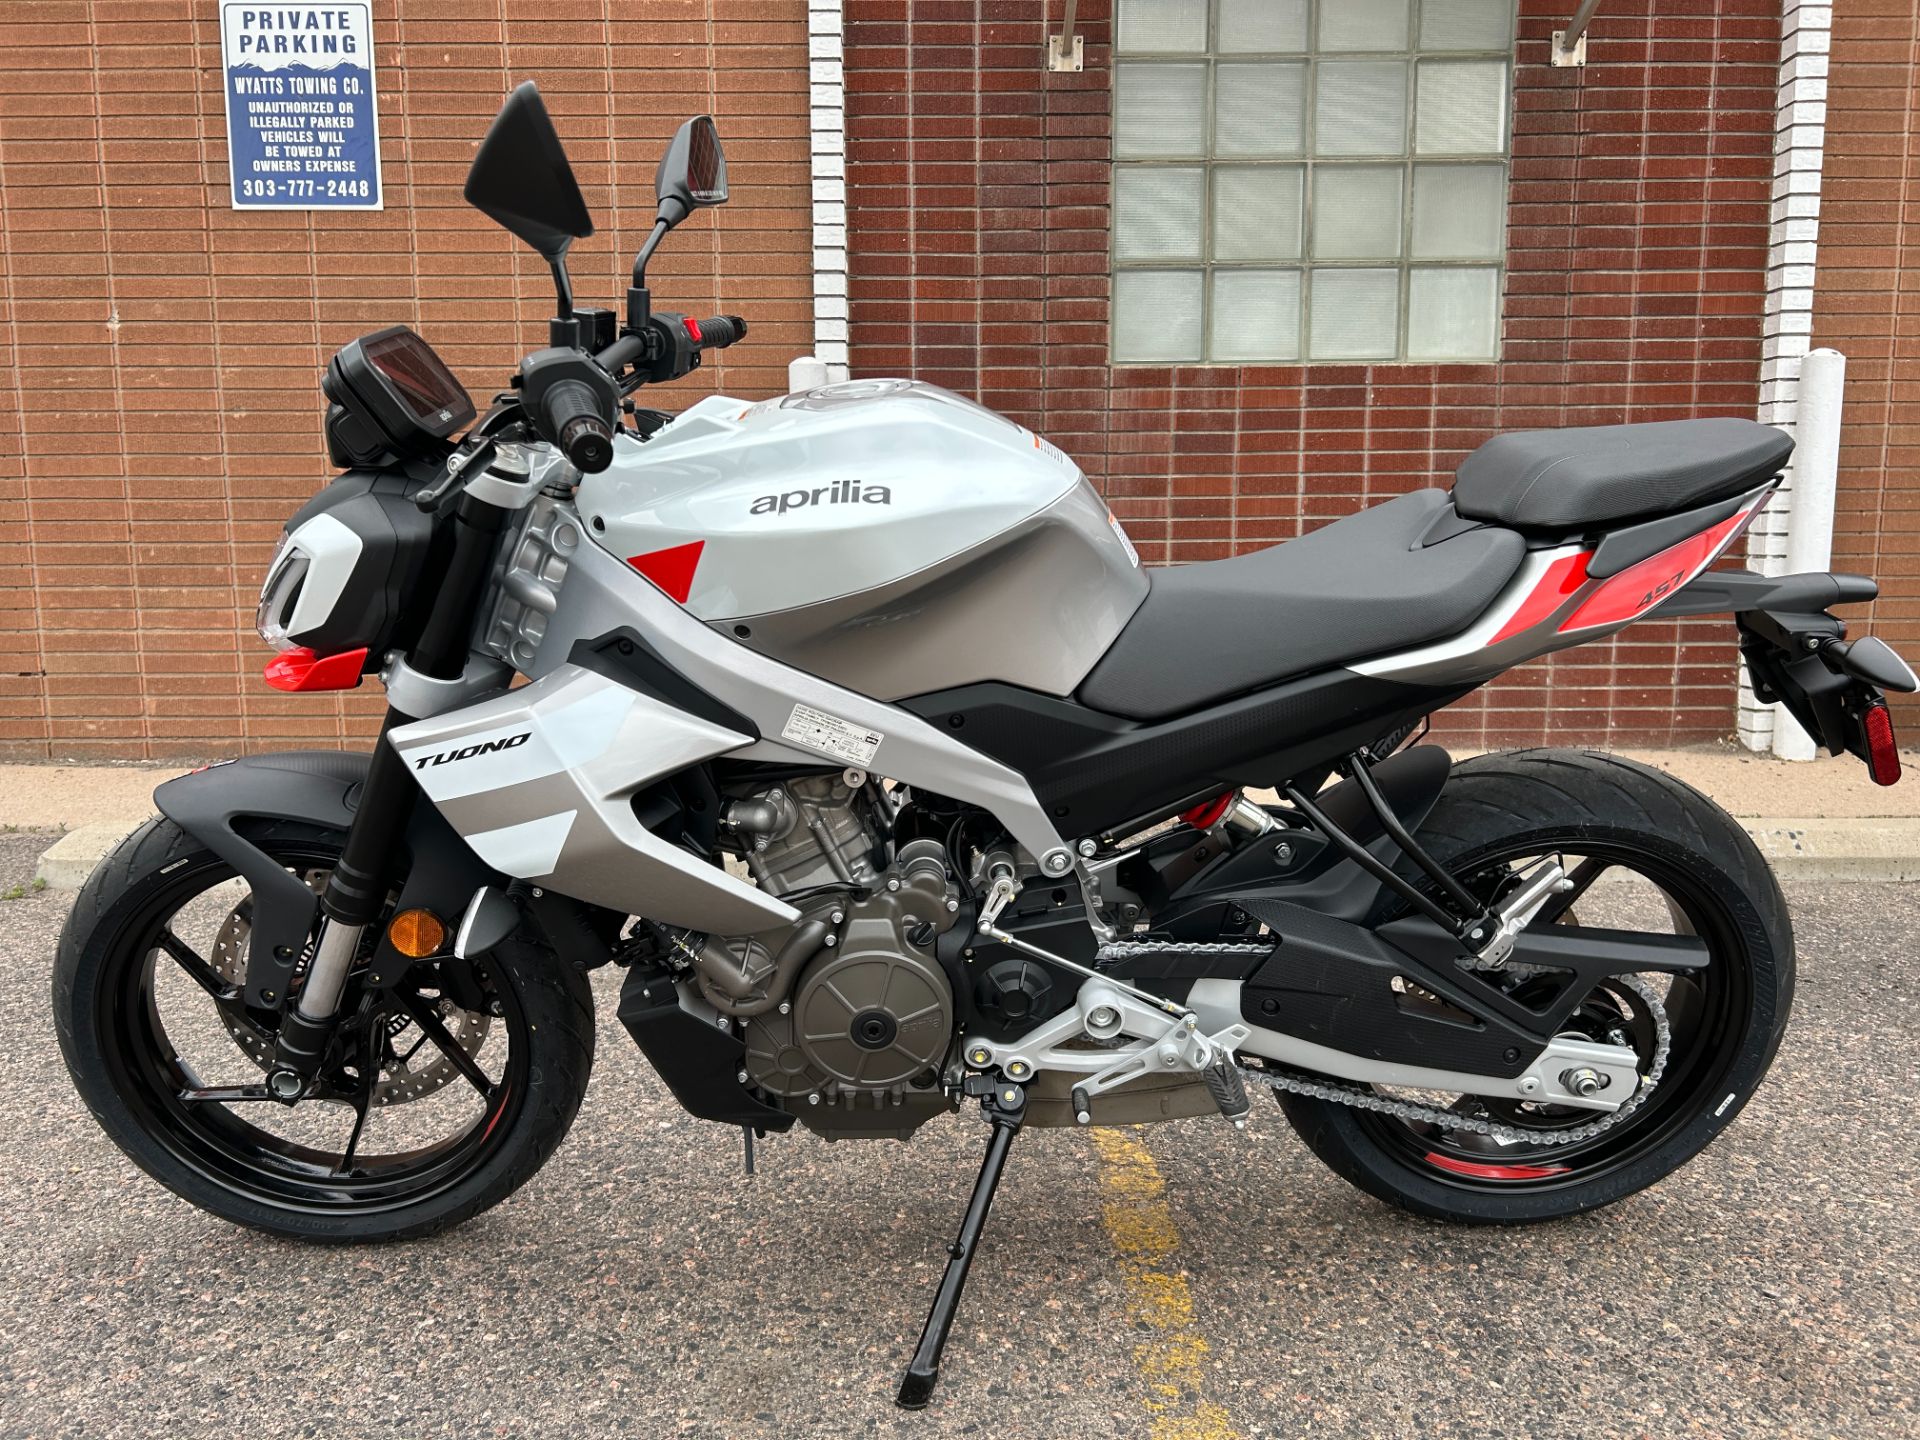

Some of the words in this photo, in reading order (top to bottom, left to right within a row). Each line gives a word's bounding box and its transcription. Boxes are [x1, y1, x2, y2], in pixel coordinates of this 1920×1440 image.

[242, 11, 351, 30] PRIVATE
[239, 35, 356, 53] PARKING
[234, 77, 284, 95] WYATTS
[289, 77, 338, 95] TOWING
[343, 77, 364, 95] CO.
[248, 102, 334, 114] UNAUTHORIZED
[338, 102, 354, 114] OR
[250, 116, 306, 129] ILLEGALLY
[310, 116, 354, 129] PARKED
[260, 131, 314, 143] VEHICLES
[318, 131, 345, 143] WILL
[265, 146, 280, 158] BE
[284, 146, 323, 158] TOWED
[327, 146, 342, 158] AT
[253, 160, 301, 172] OWNERS
[305, 160, 356, 172] EXPENSE
[243, 179, 369, 197] 303-777-2448
[750, 479, 892, 516] aprilia
[1635, 569, 1686, 610] 457
[415, 732, 533, 771] TUONO
